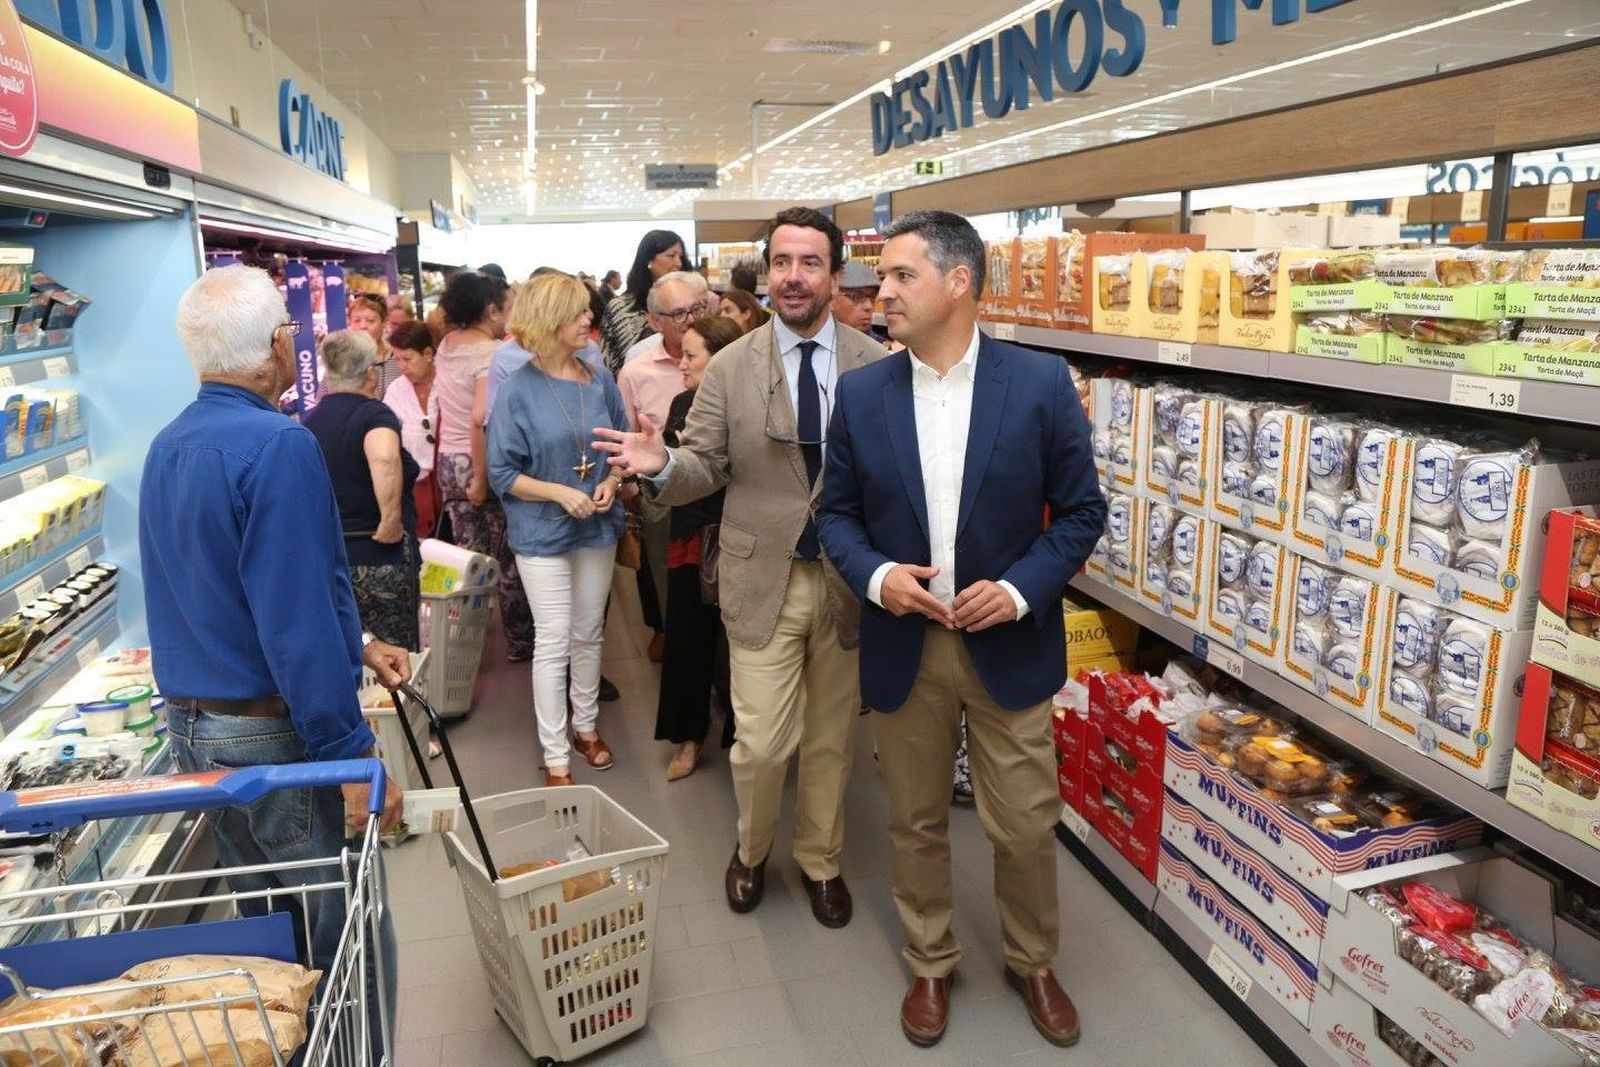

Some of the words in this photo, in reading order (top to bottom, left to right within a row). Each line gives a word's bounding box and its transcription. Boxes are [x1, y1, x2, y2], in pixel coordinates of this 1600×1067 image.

[871, 0, 1146, 156] DESAYUNOS
[278, 79, 349, 182] CARNE
[1565, 262, 1575, 271] de
[1328, 288, 1354, 296] Manzana
[1394, 292, 1411, 300] Tarta
[1412, 292, 1419, 300] de
[1421, 293, 1454, 302] Manzana
[1534, 292, 1556, 302] Tarta
[1558, 292, 1569, 302] de
[1576, 306, 1597, 315] Maçã
[1543, 325, 1585, 336] Manzana
[1332, 339, 1357, 349] Manzana
[1406, 346, 1423, 355] Tarta
[1424, 347, 1432, 356] de
[1433, 349, 1465, 360] Manzana
[1523, 353, 1545, 362] Tarta
[1546, 354, 1557, 364] de
[1558, 356, 1600, 368] Manzana
[299, 350, 319, 411] VACUNO
[1555, 368, 1563, 376] de
[1564, 368, 1584, 379] Maçã
[1488, 392, 1515, 408] 1,39
[1065, 625, 1113, 645] OBAOS
[1198, 773, 1283, 846] MUFFINS
[1194, 827, 1275, 904] MUFFINS
[1187, 882, 1265, 965] MUFFINS
[1347, 946, 1385, 974] Gofres
[1506, 991, 1530, 1021] Gofres
[1333, 1023, 1367, 1052] Gofres
